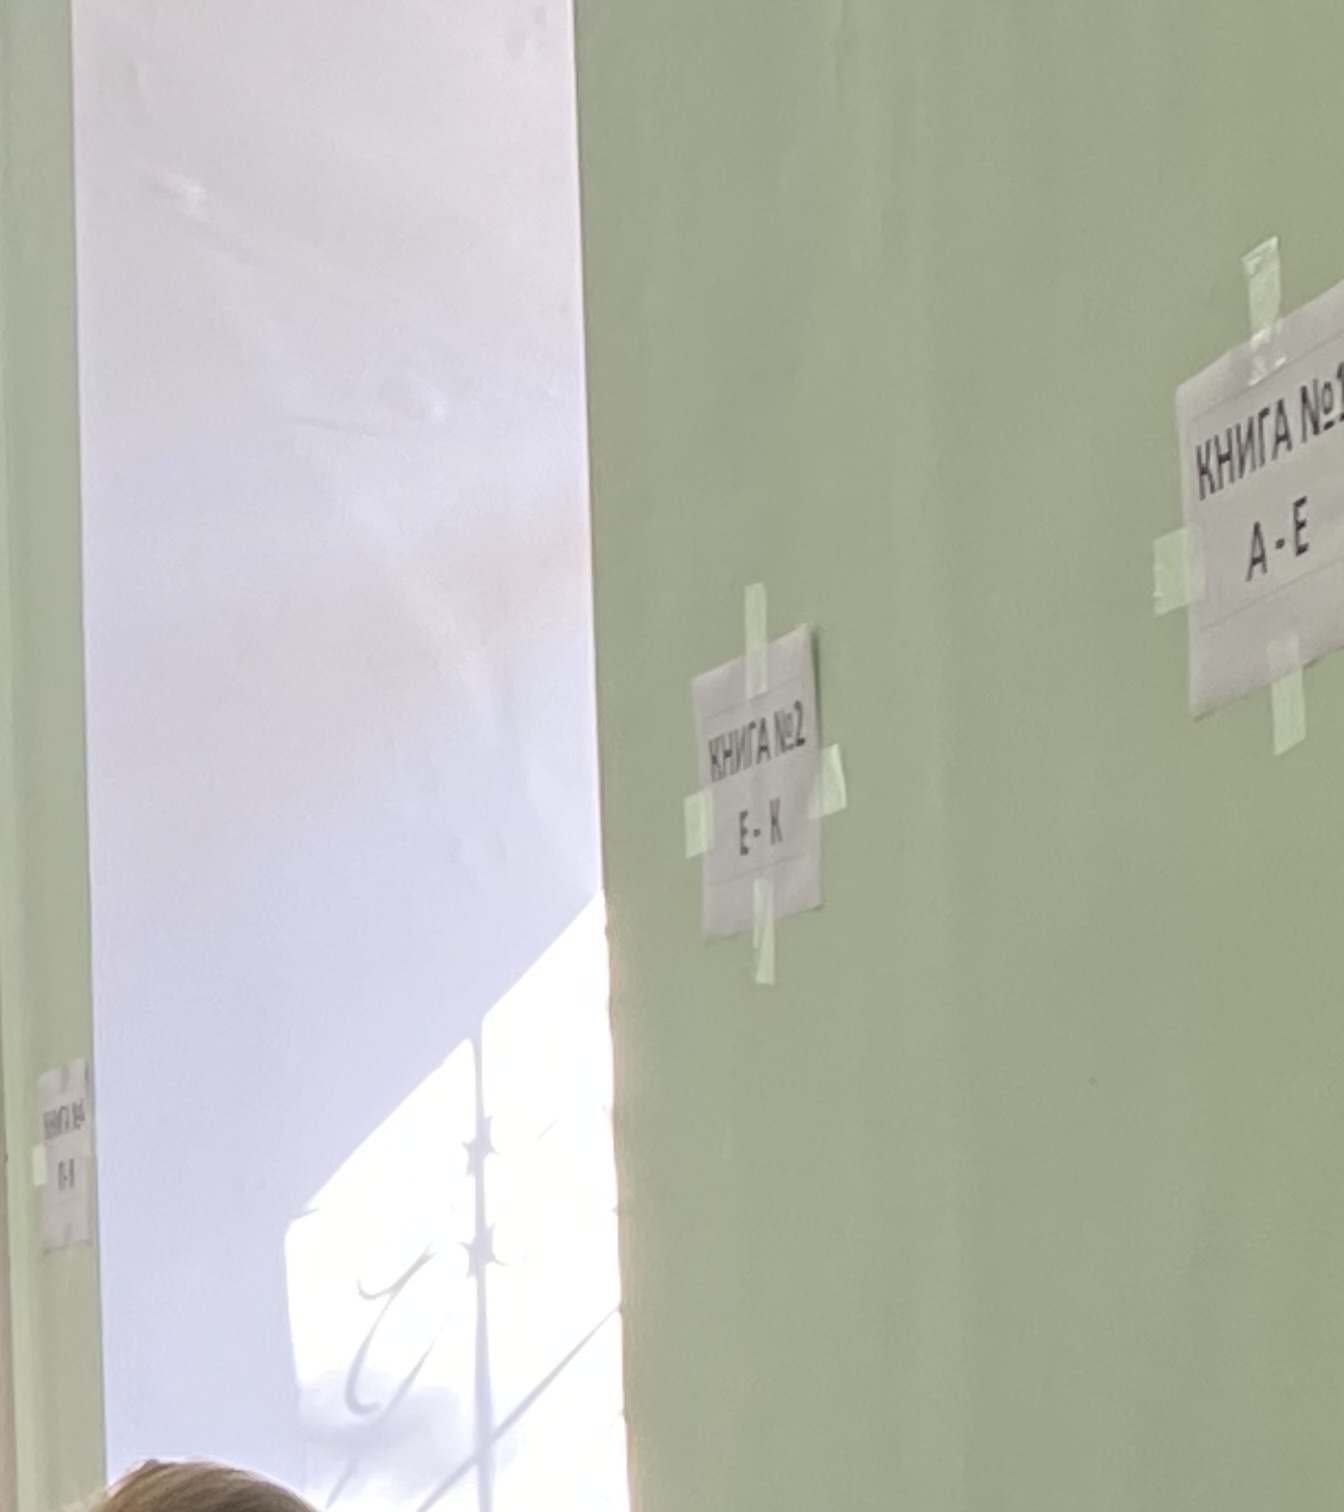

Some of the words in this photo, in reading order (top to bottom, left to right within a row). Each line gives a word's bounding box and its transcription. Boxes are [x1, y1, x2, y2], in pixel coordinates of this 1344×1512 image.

[1196, 398, 1293, 501] КНИГА
[1245, 521, 1268, 582] А
[1293, 496, 1310, 557] Е
[708, 717, 772, 783] КНИГА
[773, 700, 806, 758] №2
